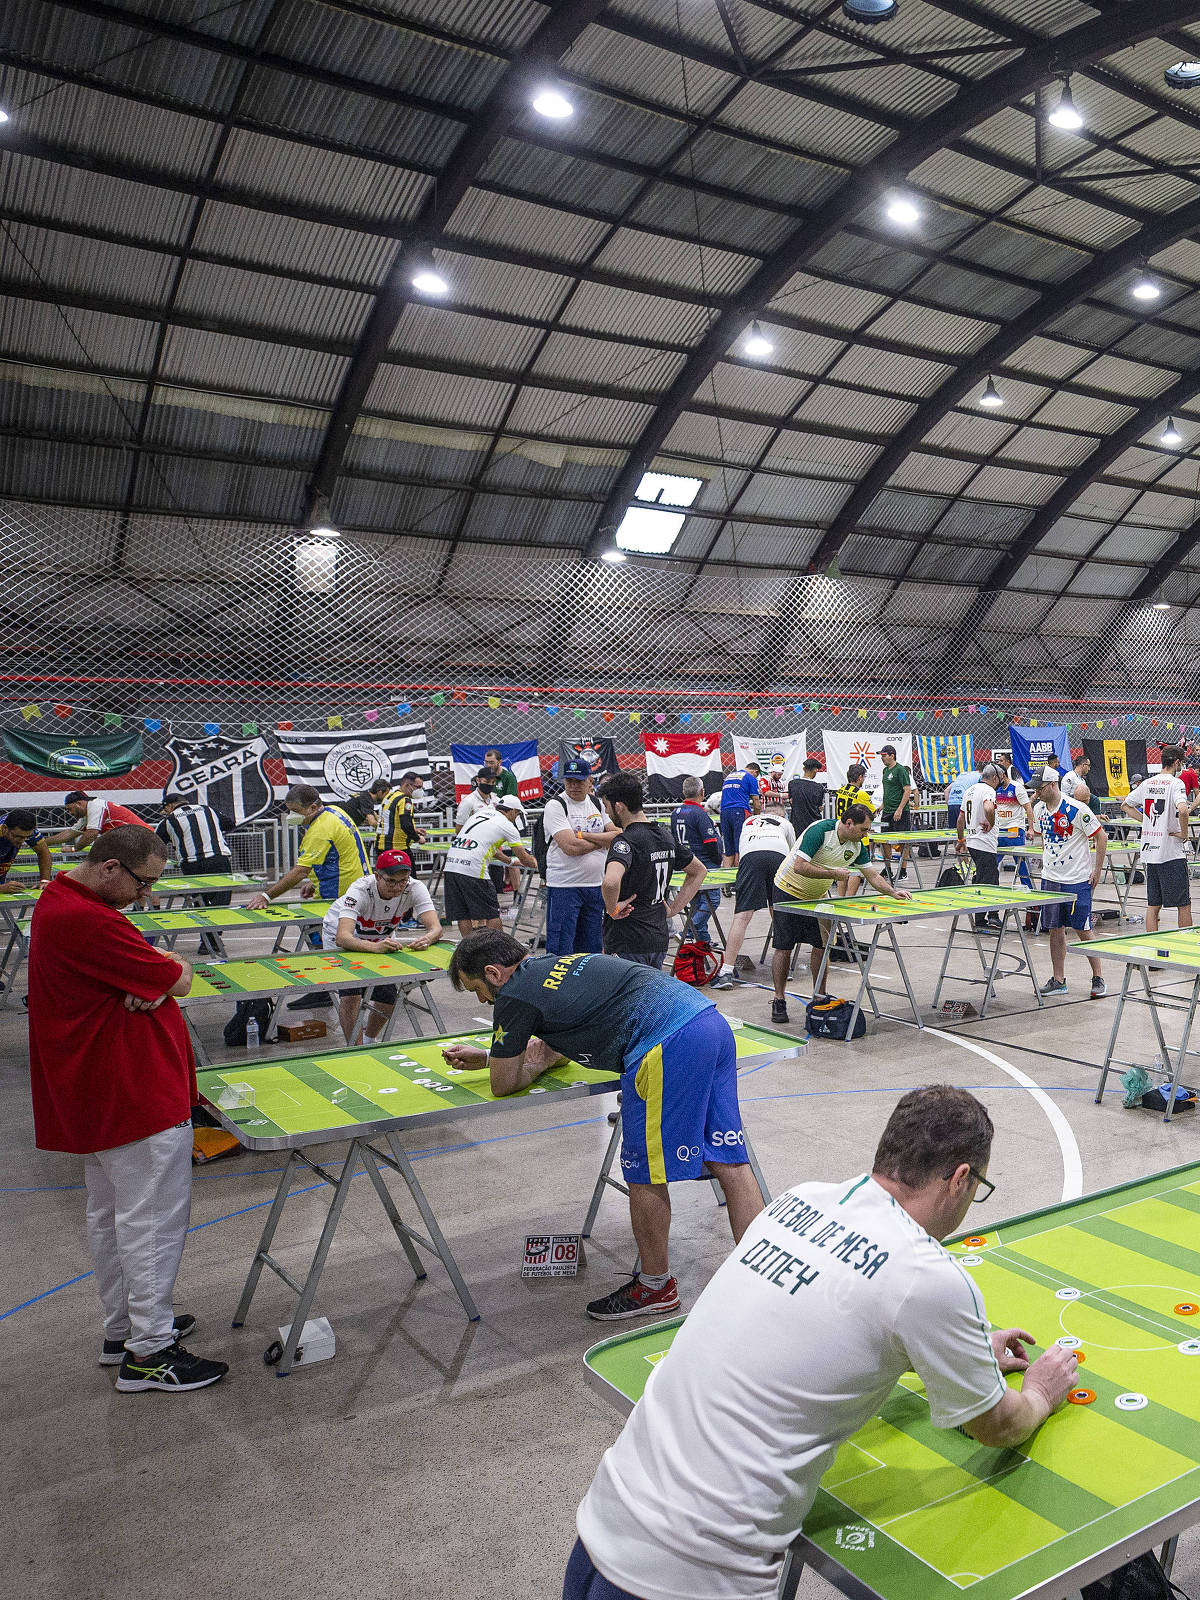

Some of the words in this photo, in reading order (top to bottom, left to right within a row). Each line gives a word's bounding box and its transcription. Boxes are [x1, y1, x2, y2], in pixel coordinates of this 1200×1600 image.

[1029, 742, 1053, 753] AABB
[175, 745, 258, 792] CEARÁ
[464, 815, 490, 834] 7
[966, 800, 972, 825] 8
[554, 1244, 576, 1260] 08
[809, 1221, 845, 1248] DE
[830, 1231, 890, 1280] MESA
[739, 1238, 820, 1296] DINEY
